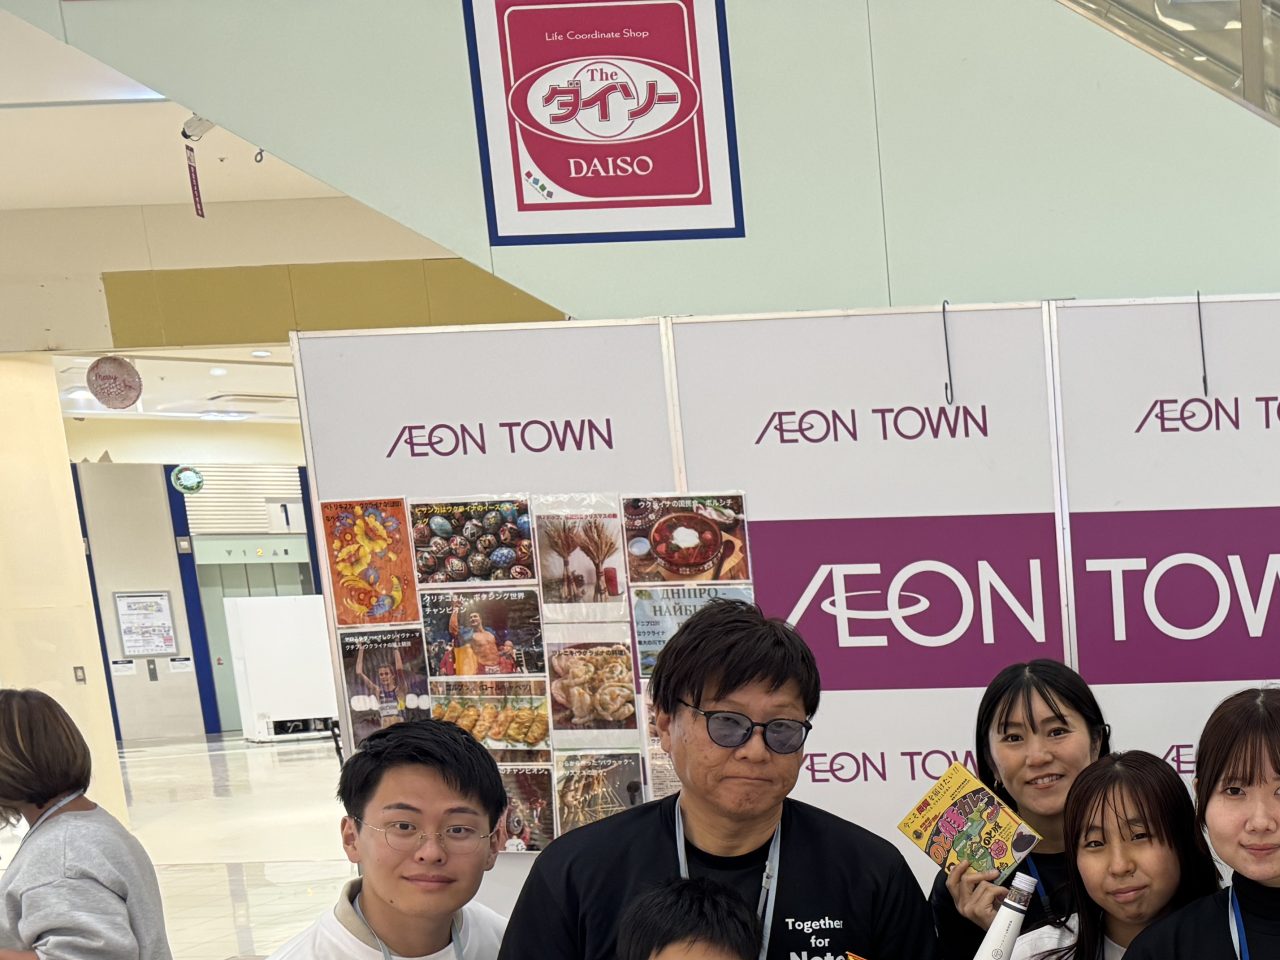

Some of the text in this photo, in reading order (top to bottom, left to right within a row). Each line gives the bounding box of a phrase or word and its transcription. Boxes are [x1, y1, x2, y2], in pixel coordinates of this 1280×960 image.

[545, 28, 649, 41] Life Coordinate Shop
[586, 68, 619, 82] The
[542, 80, 679, 124] ダイソー
[568, 155, 653, 177] DAISO
[872, 405, 988, 440] TOWN
[499, 418, 613, 454] TOWN
[901, 751, 978, 781] TOW
[785, 917, 843, 932] Together
[810, 935, 830, 948] for
